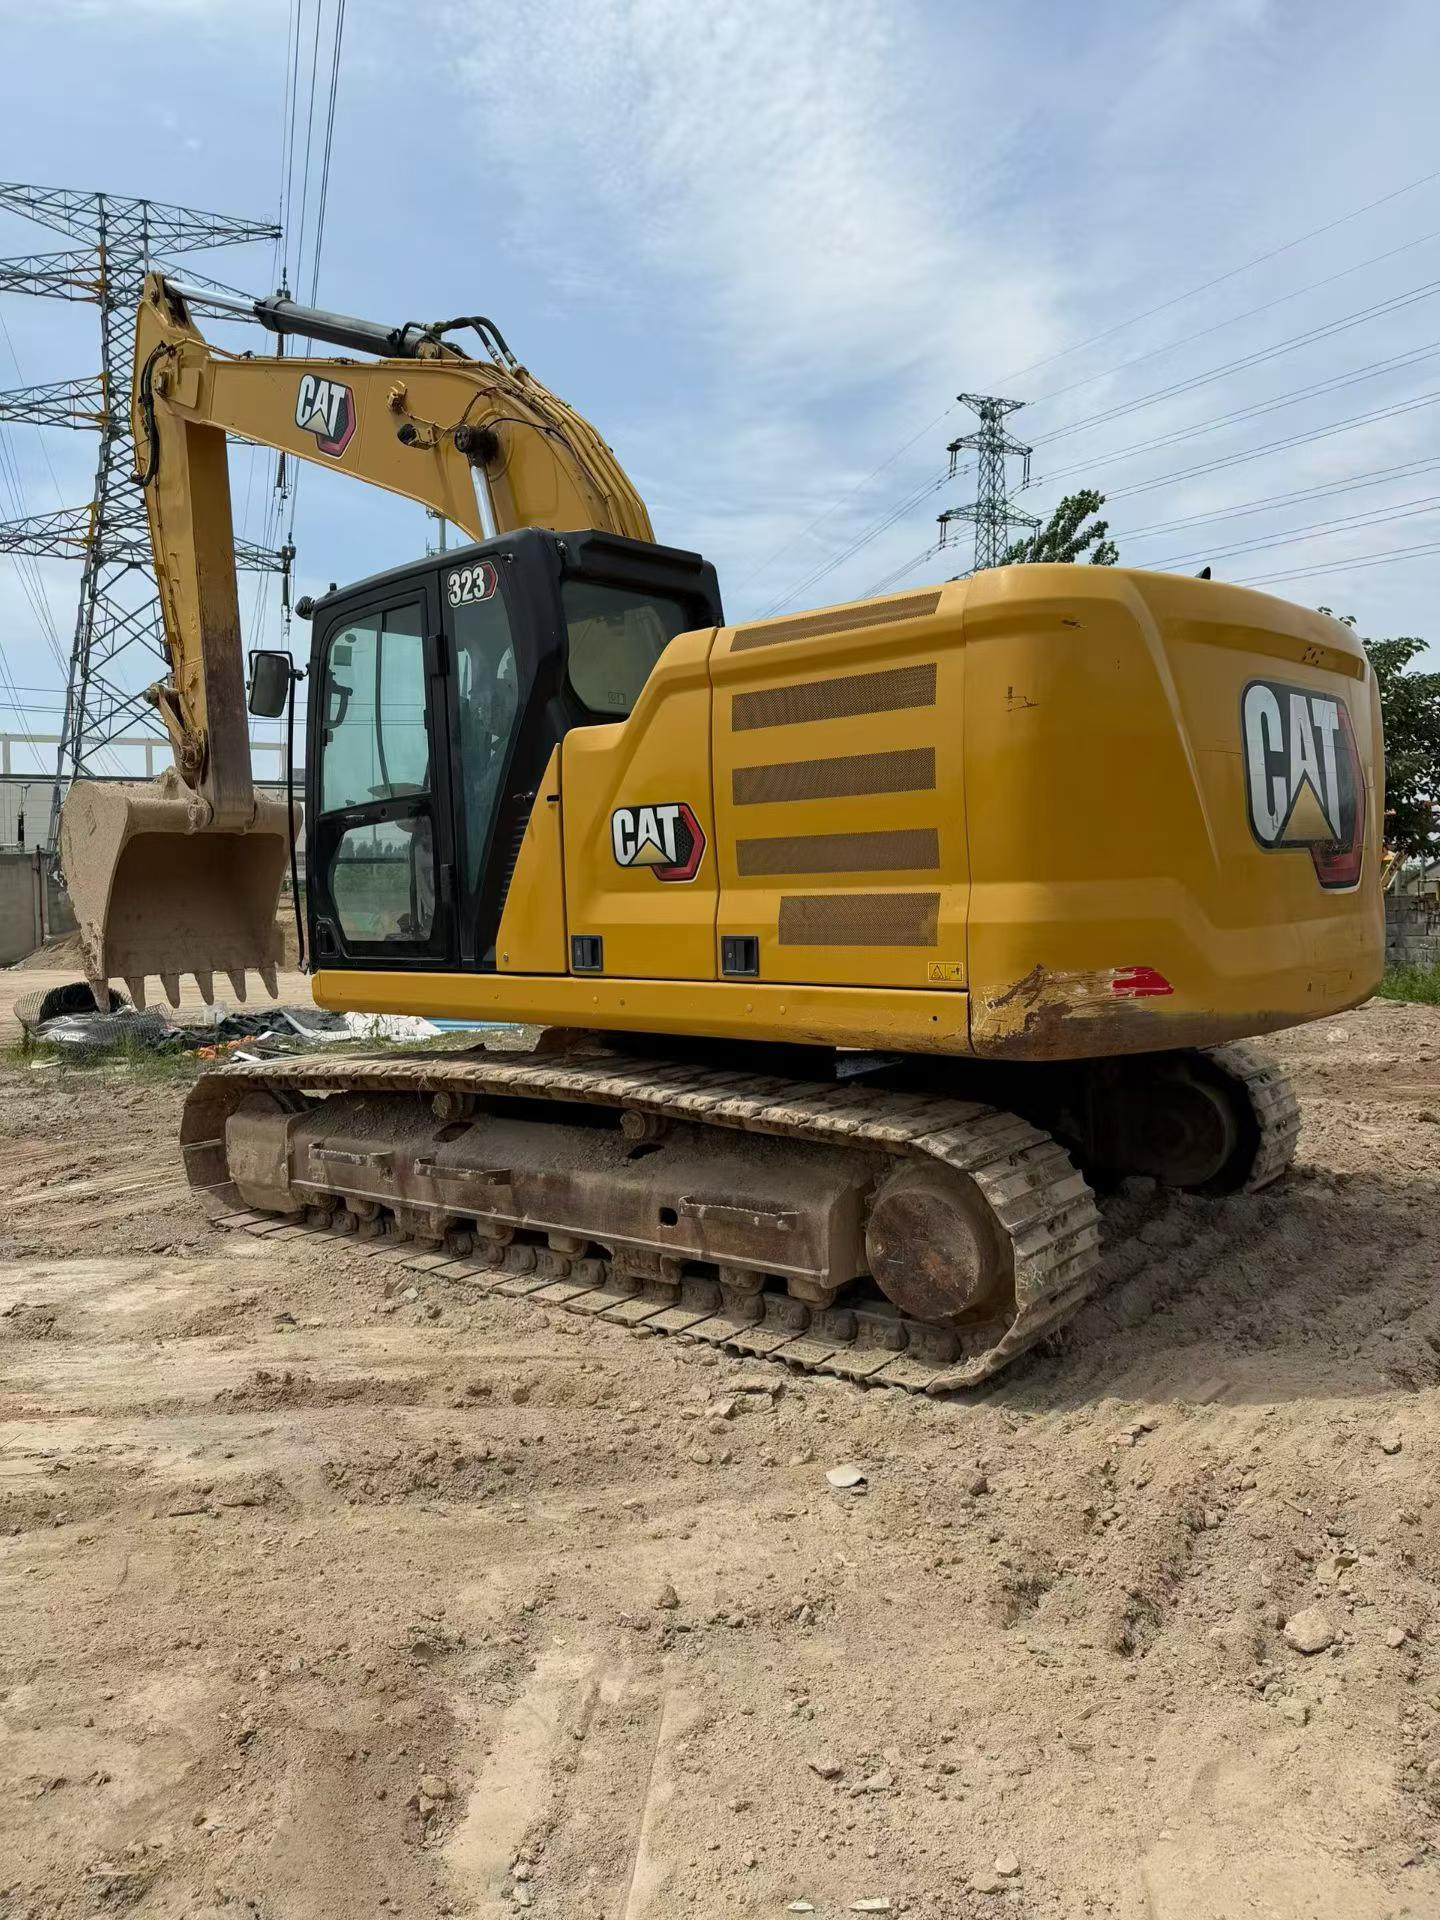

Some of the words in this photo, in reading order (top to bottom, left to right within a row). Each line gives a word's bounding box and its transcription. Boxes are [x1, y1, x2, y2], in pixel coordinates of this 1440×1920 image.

[295, 375, 346, 437] CAT
[449, 566, 485, 604] 323
[1244, 685, 1341, 841] CAT
[612, 805, 679, 865] CAT
